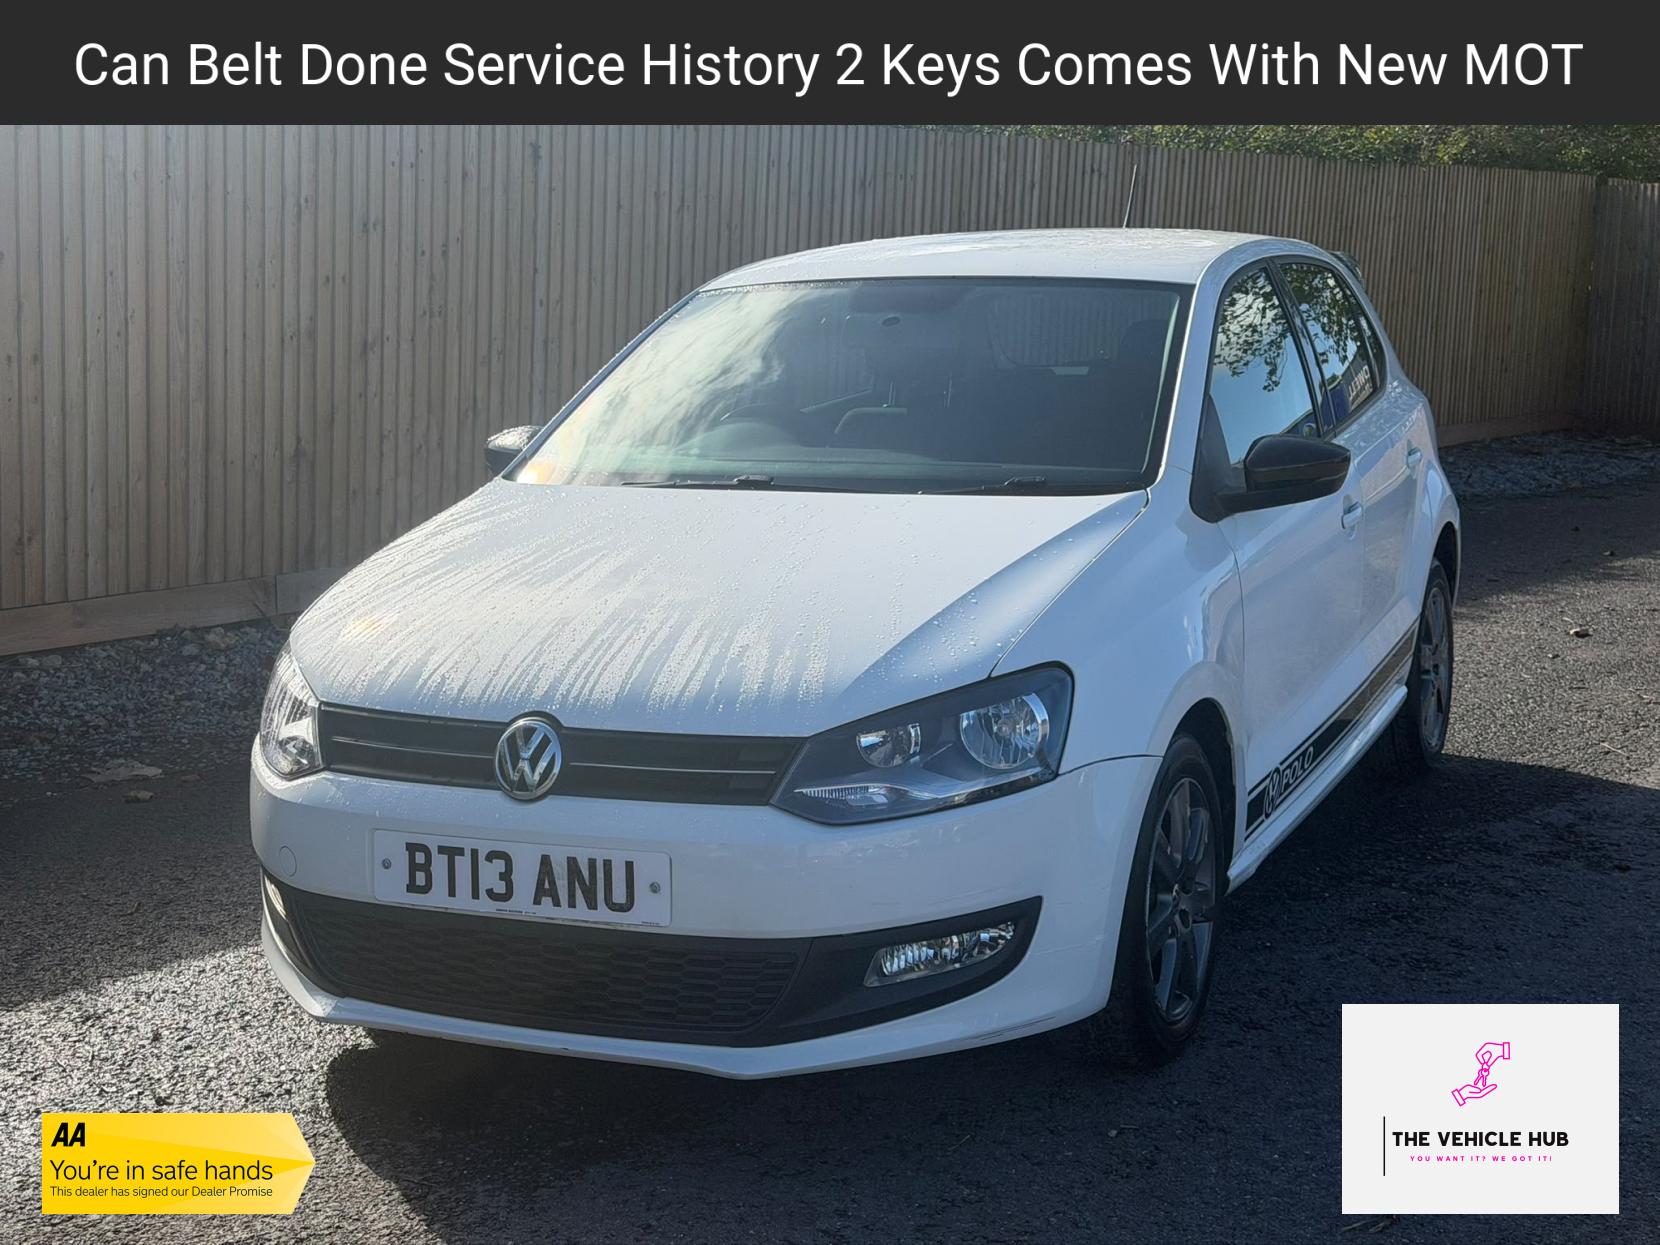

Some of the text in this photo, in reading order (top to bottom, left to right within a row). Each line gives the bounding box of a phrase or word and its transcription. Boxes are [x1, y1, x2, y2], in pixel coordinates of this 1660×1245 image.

[1281, 745, 1314, 793] POLO
[405, 840, 636, 914] BT13 ANU
